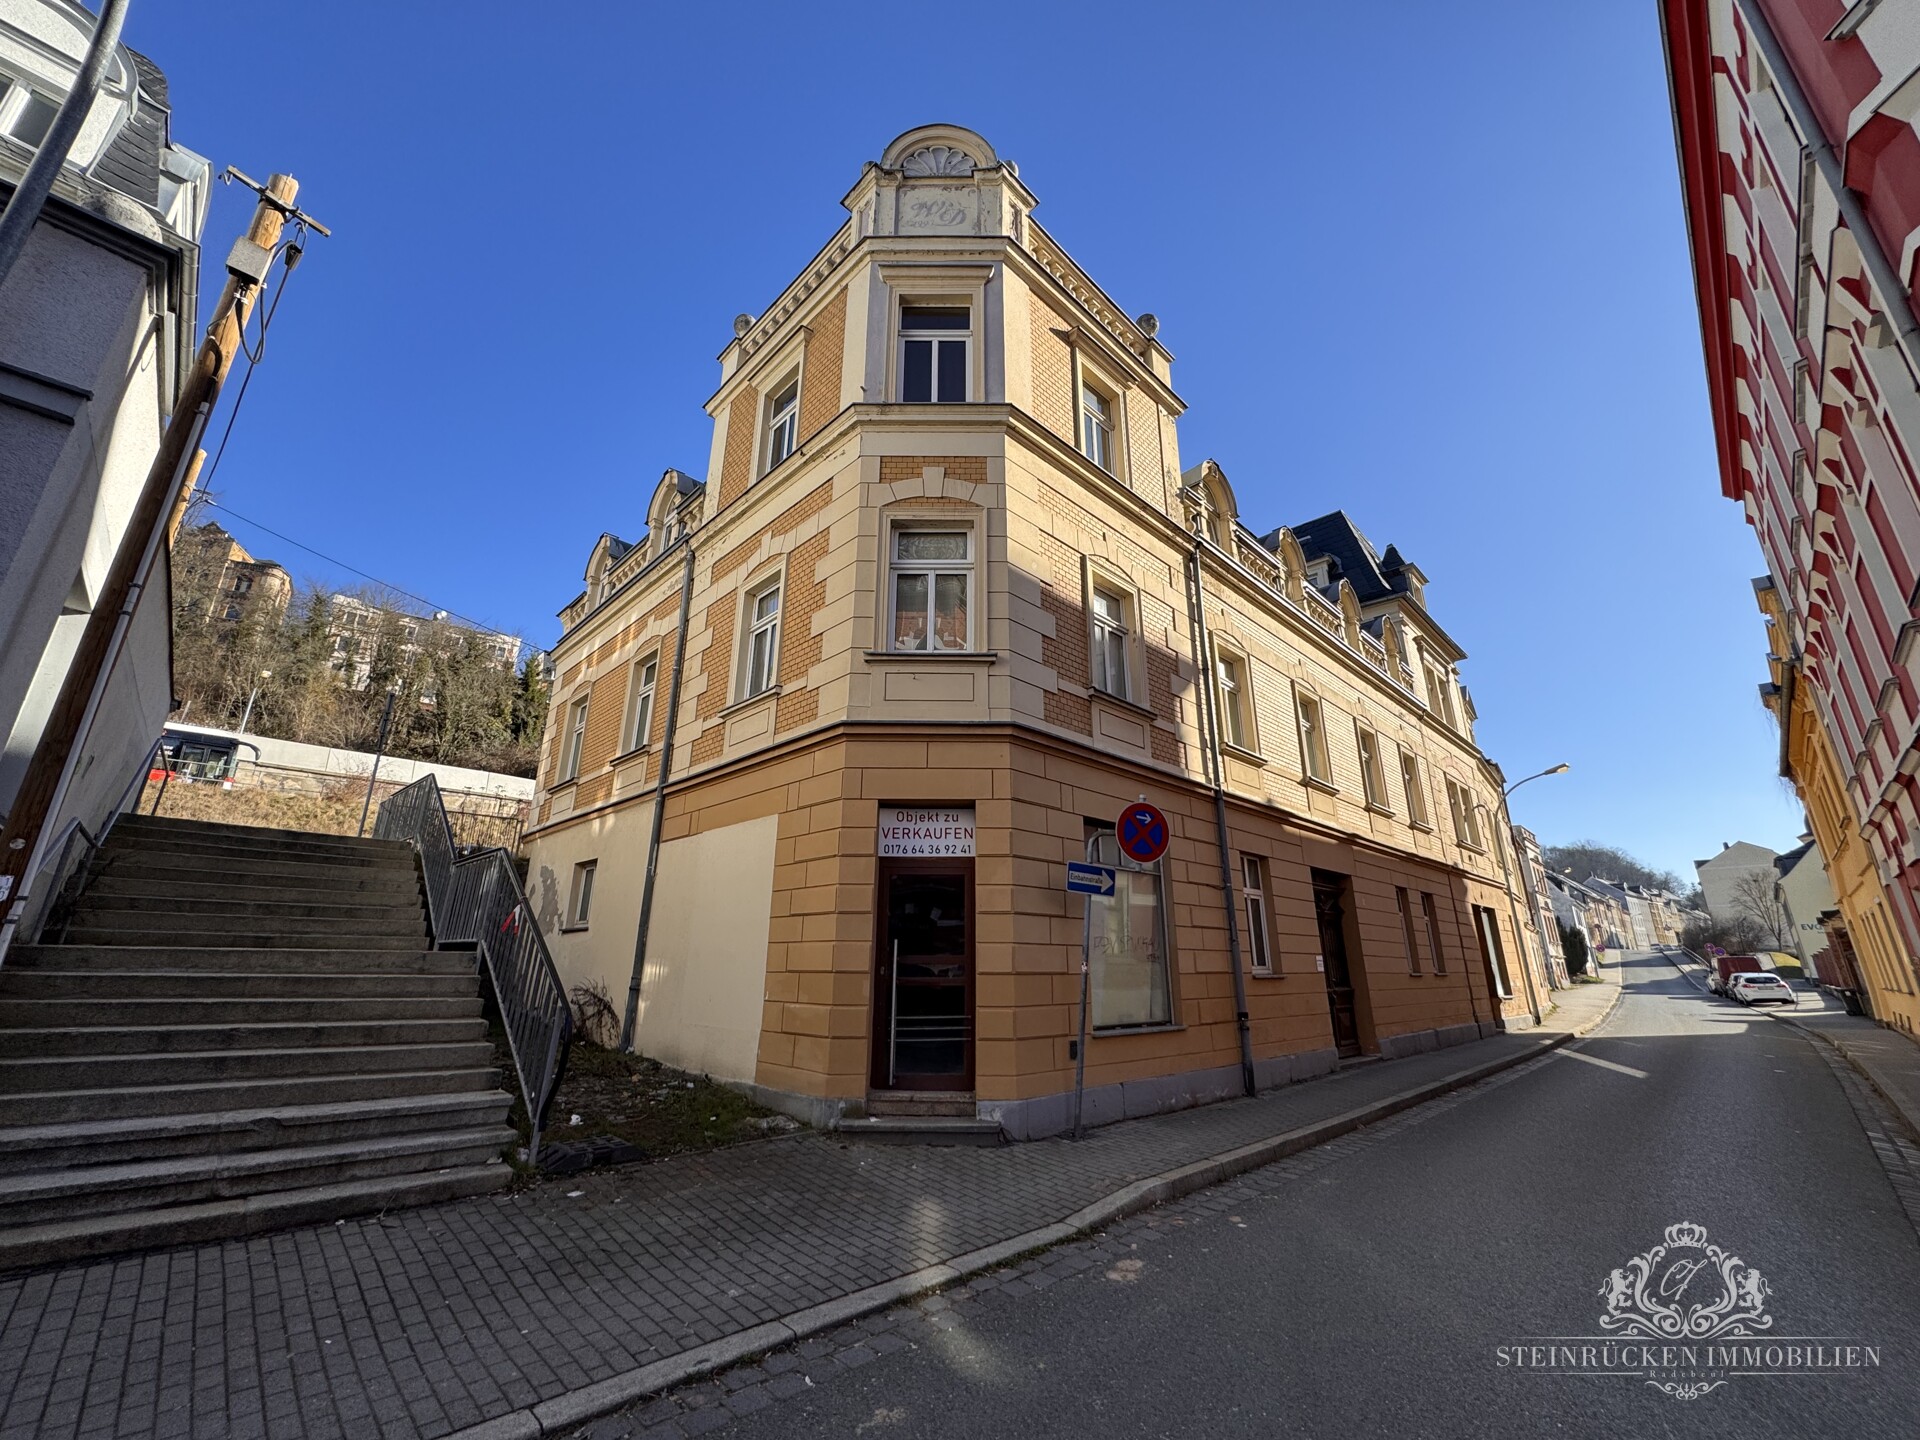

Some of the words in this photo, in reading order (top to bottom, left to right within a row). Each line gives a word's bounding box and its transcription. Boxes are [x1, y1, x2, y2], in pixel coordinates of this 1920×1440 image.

[896, 811, 939, 825] Objekt
[944, 813, 959, 822] zu
[881, 827, 974, 839] VERKAUFEN
[883, 844, 908, 854] 0176
[911, 844, 924, 854] 64
[928, 844, 941, 854] 36
[944, 844, 957, 854] 92
[960, 844, 971, 854] 41
